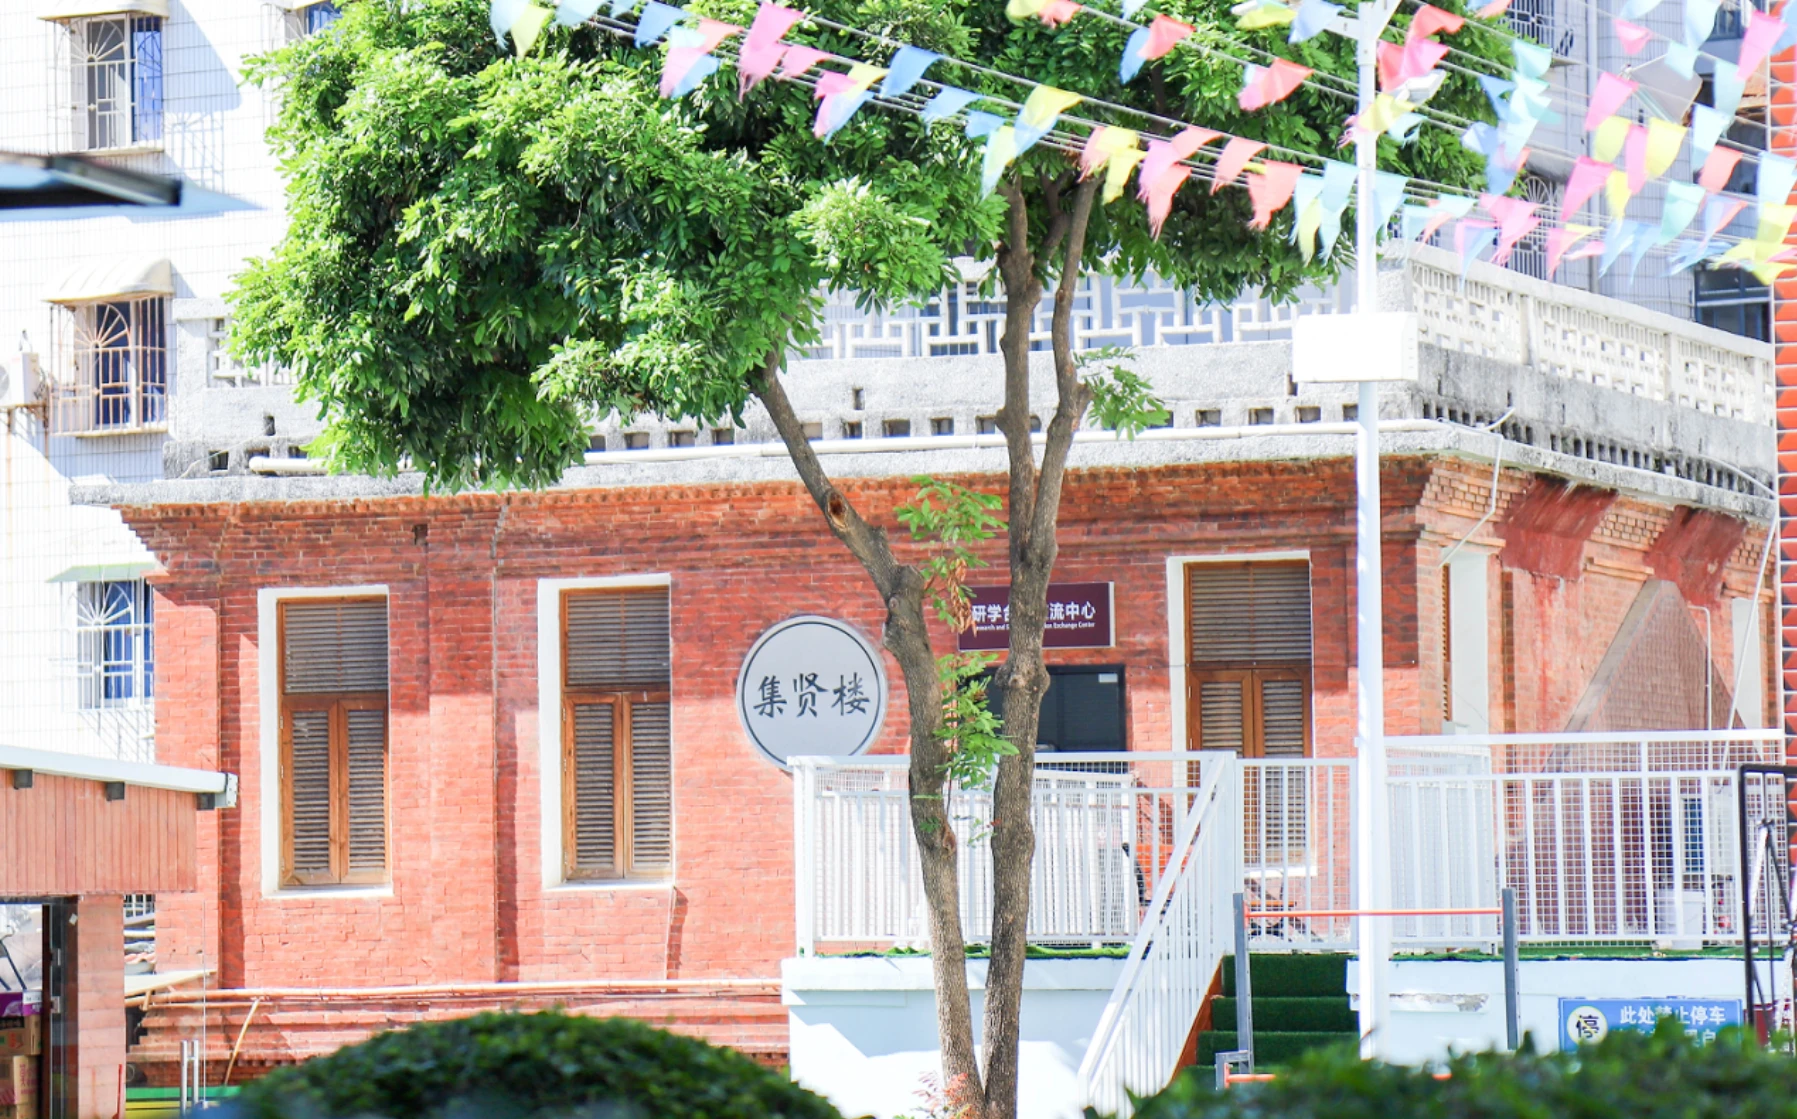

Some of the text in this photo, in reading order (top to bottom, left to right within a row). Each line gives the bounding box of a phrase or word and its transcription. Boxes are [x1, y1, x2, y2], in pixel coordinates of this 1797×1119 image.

[753, 672, 870, 718] 集贤楼
[1575, 1014, 1600, 1038] 停
